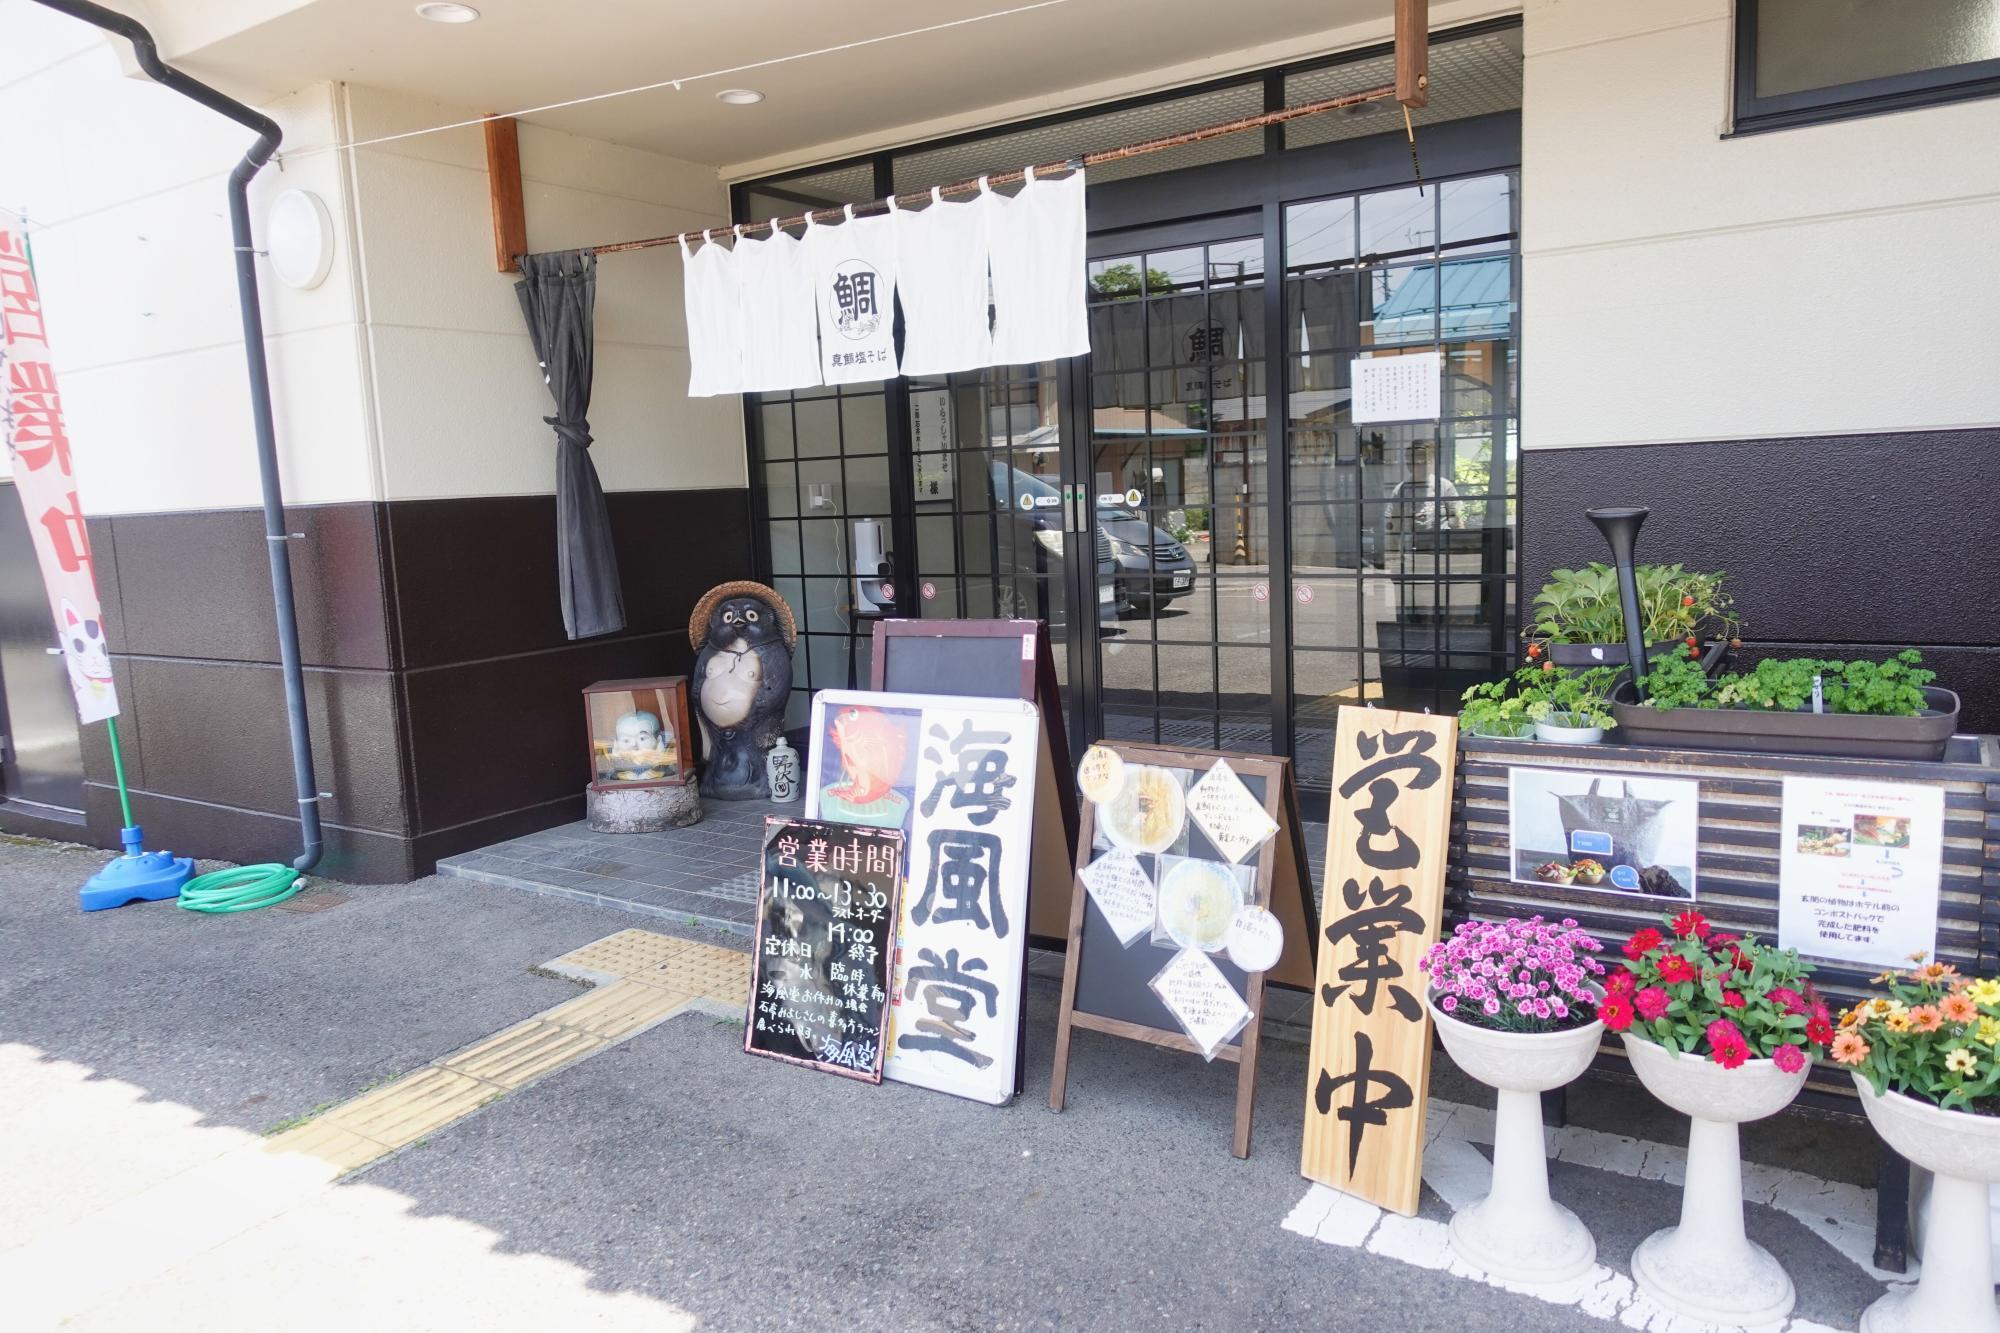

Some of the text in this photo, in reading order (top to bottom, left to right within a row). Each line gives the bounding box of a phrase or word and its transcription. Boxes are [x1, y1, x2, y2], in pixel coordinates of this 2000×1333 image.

[833, 271, 878, 325] 鯛
[832, 347, 888, 367] 真鯛塩そば
[778, 836, 895, 878] 営業時間
[898, 718, 1018, 1072] 海風堂
[1801, 894, 1900, 912] 玄関の植物はホテル前の
[832, 906, 885, 924] ラストオーダー
[1813, 908, 1885, 923] コンポストバッグで
[828, 921, 874, 944] 14:00
[1817, 919, 1880, 935] 完成した肥料を
[1819, 930, 1875, 945] 使用してます。
[765, 934, 812, 958] 定休日
[1314, 729, 1442, 1182] 営業中
[800, 963, 814, 980] 水
[830, 961, 866, 986] 臨時
[760, 980, 869, 1014] 海風堂お休みの場合
[817, 1034, 877, 1072] 海風堂
